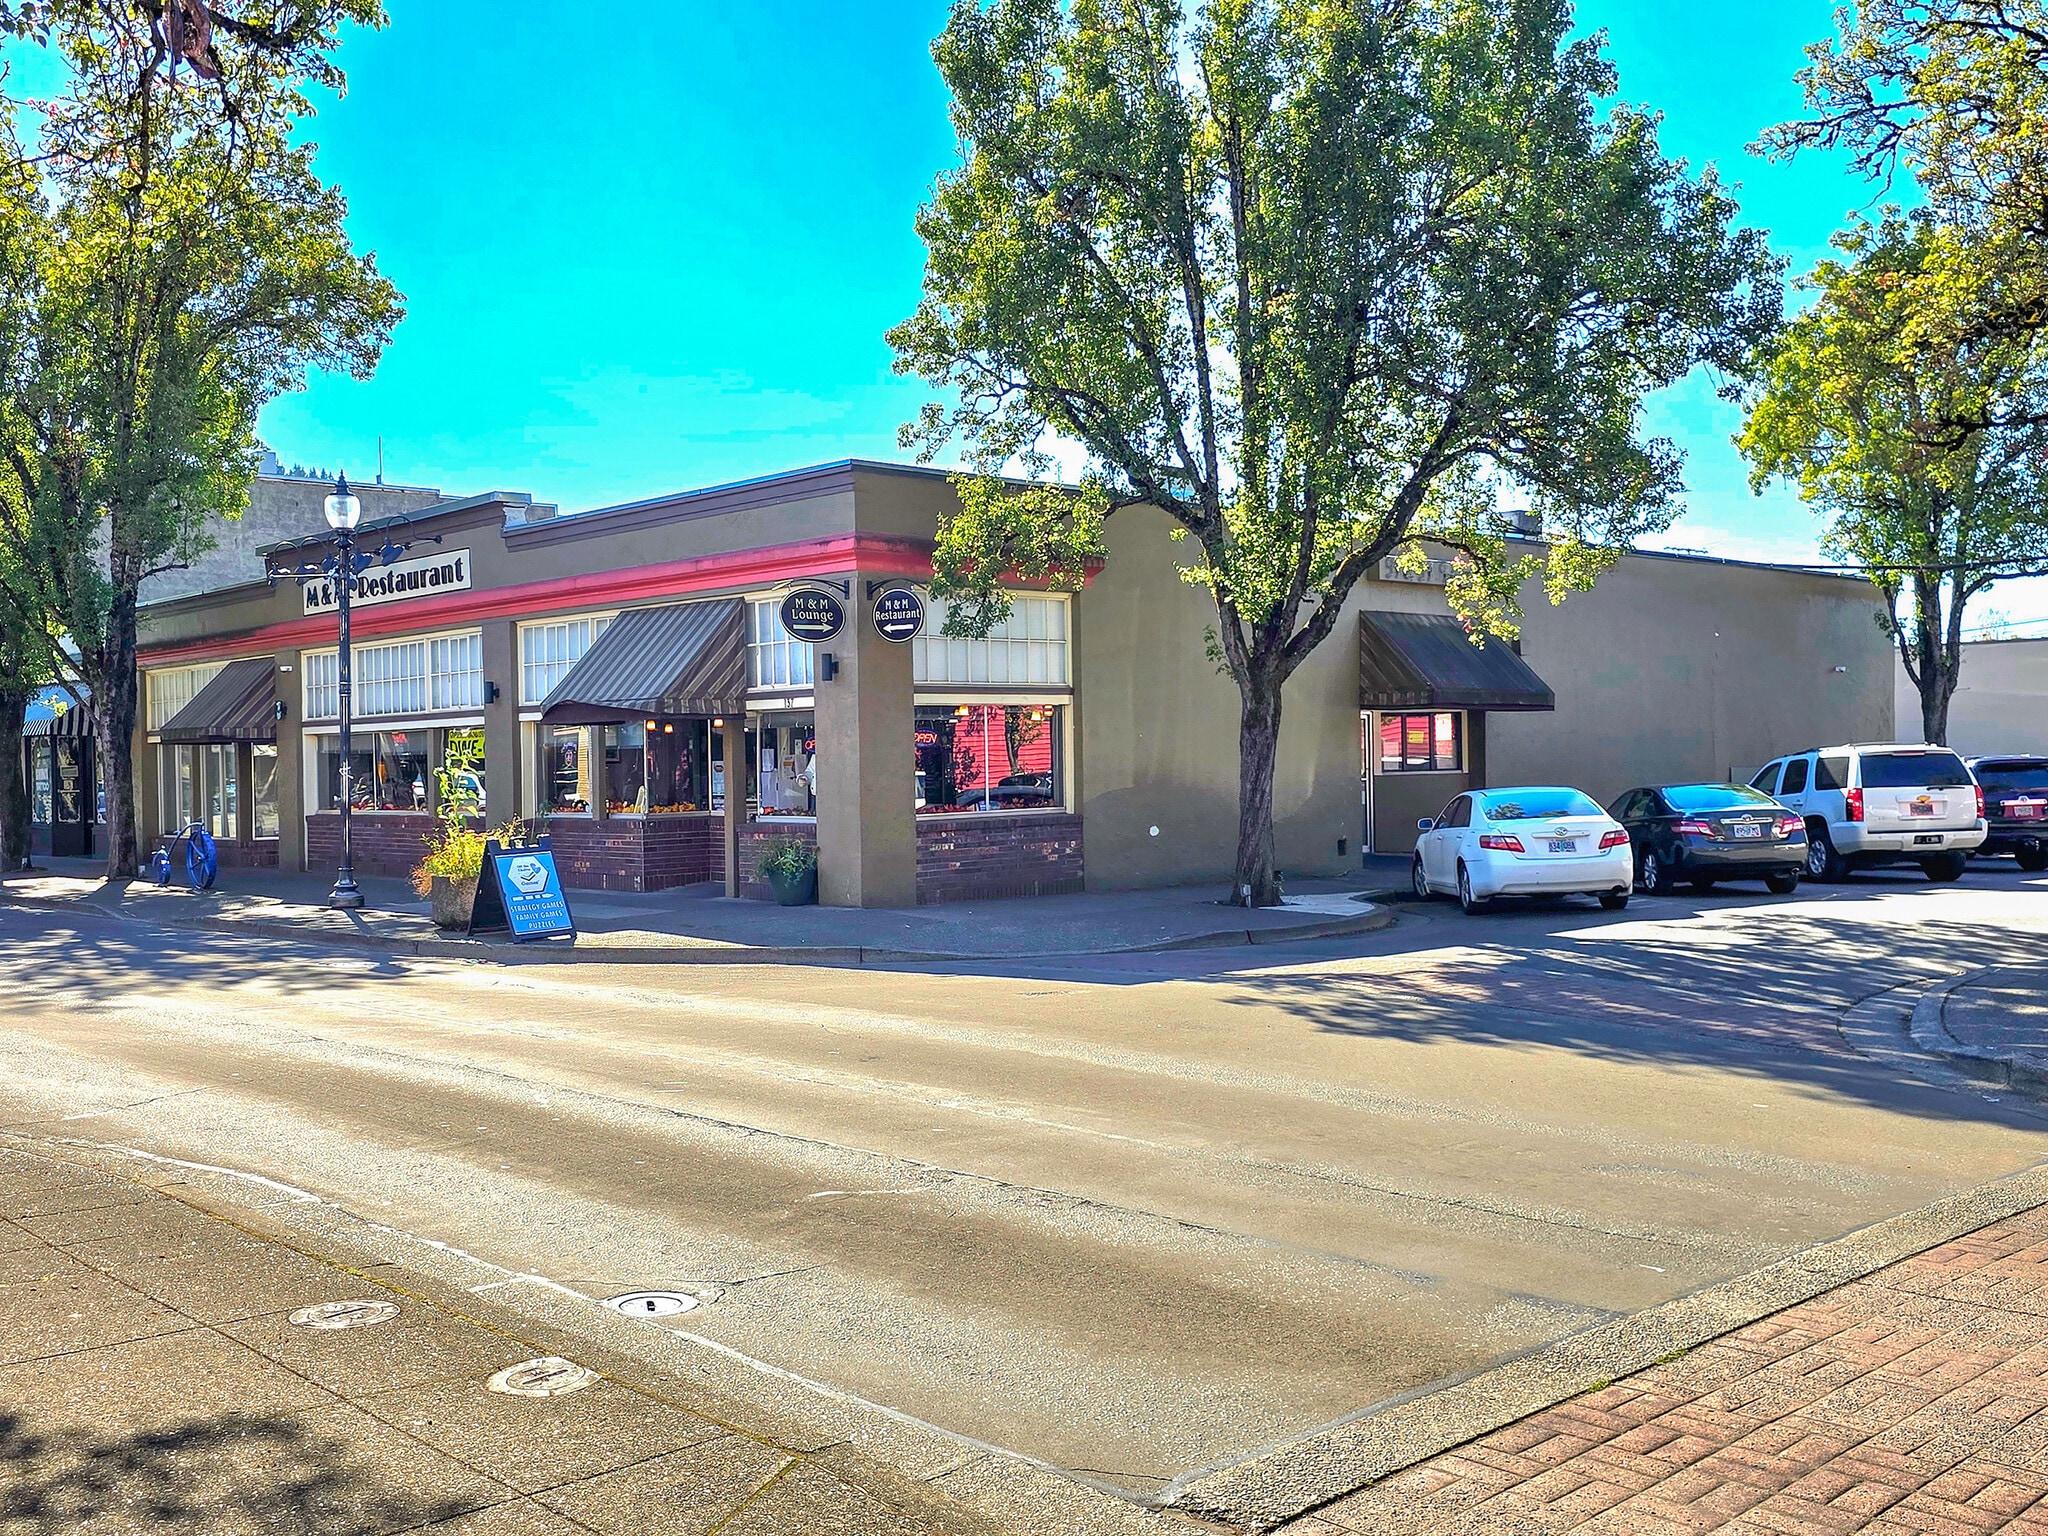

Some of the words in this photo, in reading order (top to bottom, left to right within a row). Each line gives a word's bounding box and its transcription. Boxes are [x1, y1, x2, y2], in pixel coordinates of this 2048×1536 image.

[358, 557, 464, 599] Restaurant
[795, 598, 804, 609] M
[819, 599, 829, 609] M
[792, 608, 834, 623] Lounge
[875, 608, 921, 621] Restaurant
[784, 698, 794, 709] 157
[914, 732, 937, 744] OPEN
[510, 904, 540, 913] STRATEGY
[541, 901, 564, 910] GAMES
[516, 912, 539, 921] FAMILY
[541, 910, 563, 919] GAMES
[528, 920, 556, 929] PUZZLES
